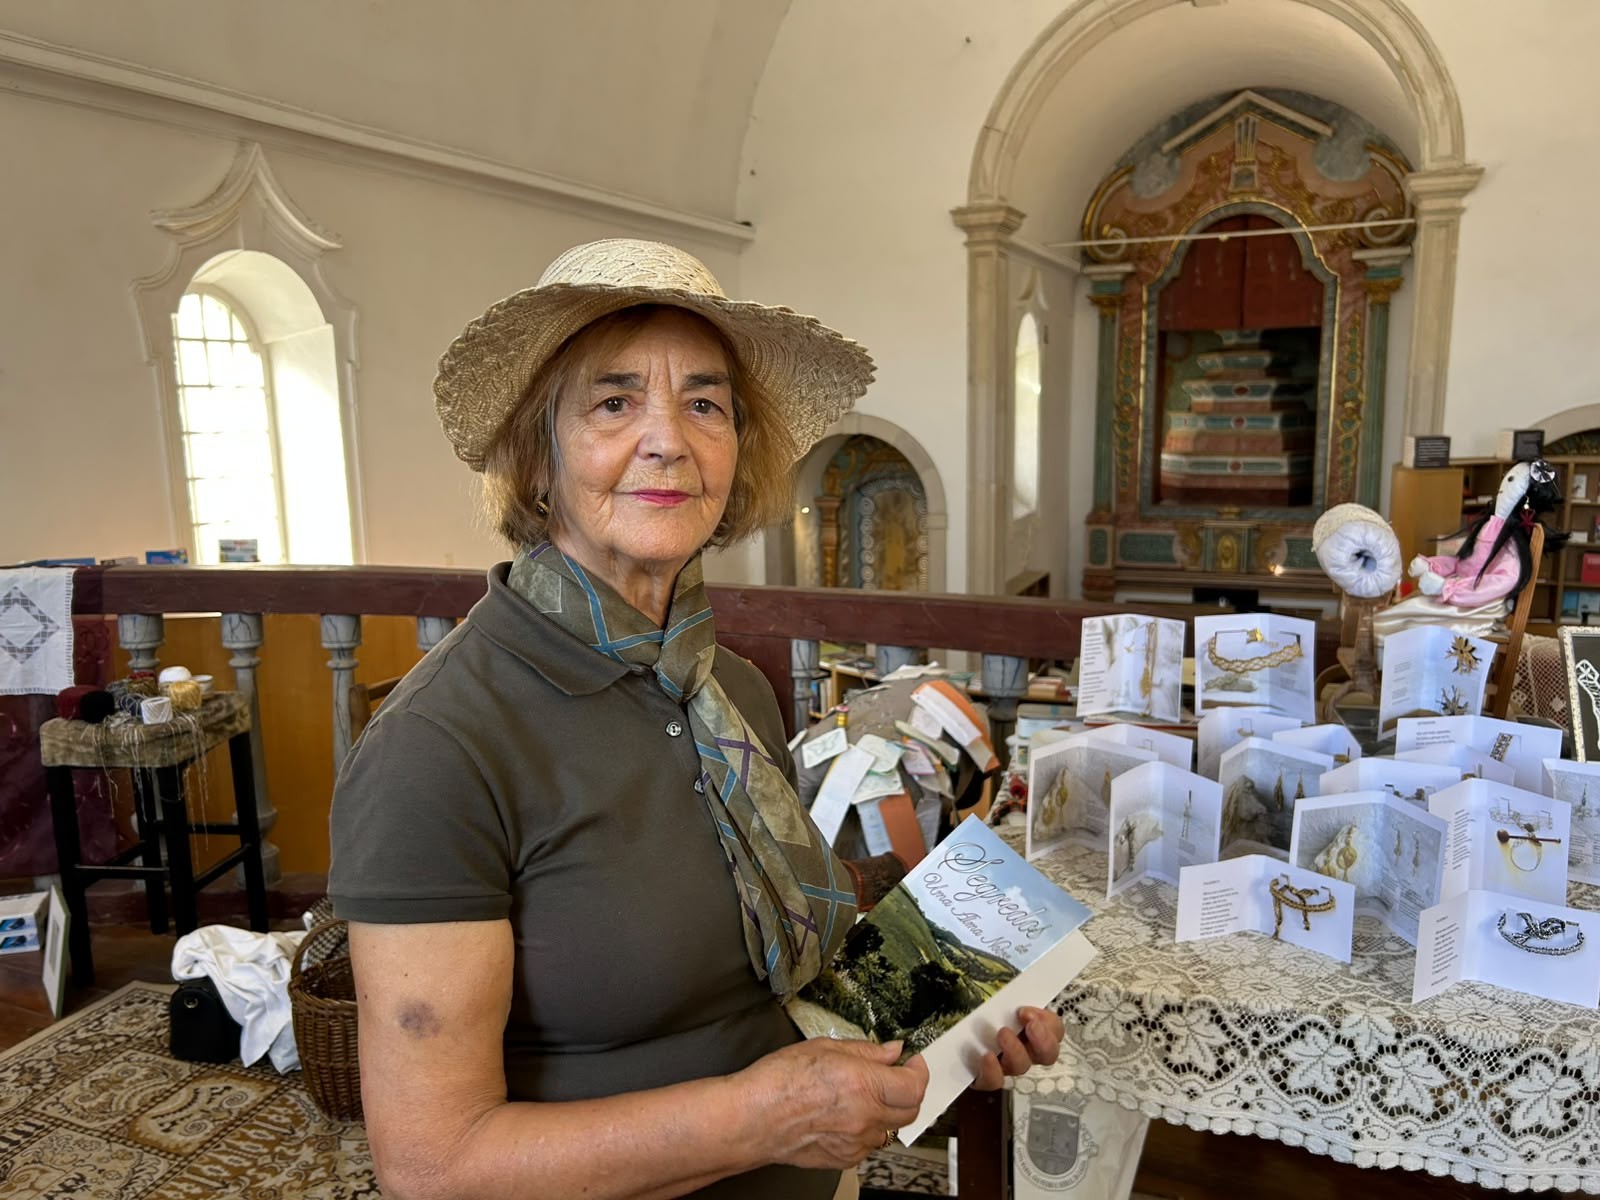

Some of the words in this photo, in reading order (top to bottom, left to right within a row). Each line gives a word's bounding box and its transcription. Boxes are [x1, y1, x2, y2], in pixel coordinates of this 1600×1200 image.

[923, 872, 952, 907] Uma
[951, 907, 984, 937] Alma
[938, 842, 1053, 939] Segredos
